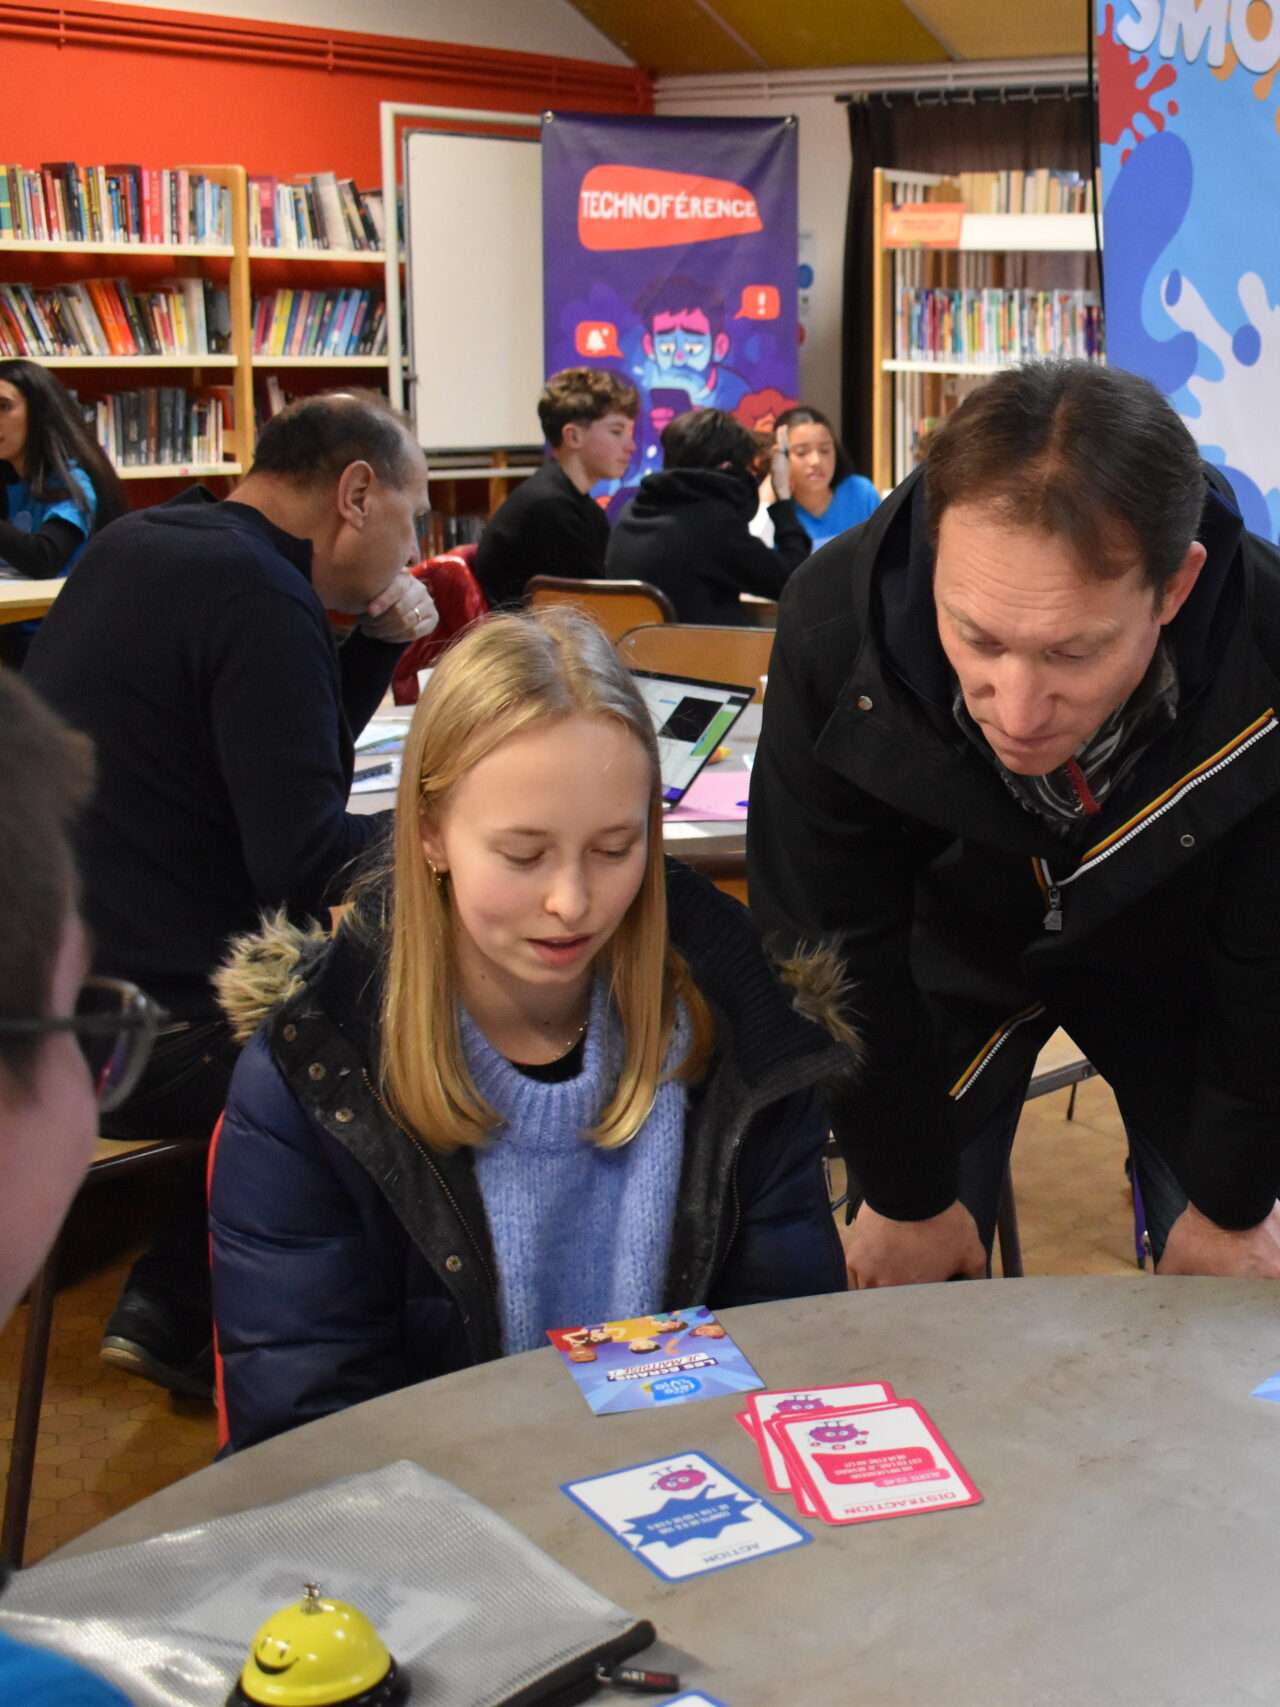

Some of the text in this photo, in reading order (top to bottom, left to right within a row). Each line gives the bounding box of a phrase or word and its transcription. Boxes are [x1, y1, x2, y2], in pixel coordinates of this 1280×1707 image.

[581, 189, 758, 220] TECHNOFÉRENCE
[844, 1491, 957, 1515] DISTRACTION
[704, 1543, 760, 1563] ACTION
